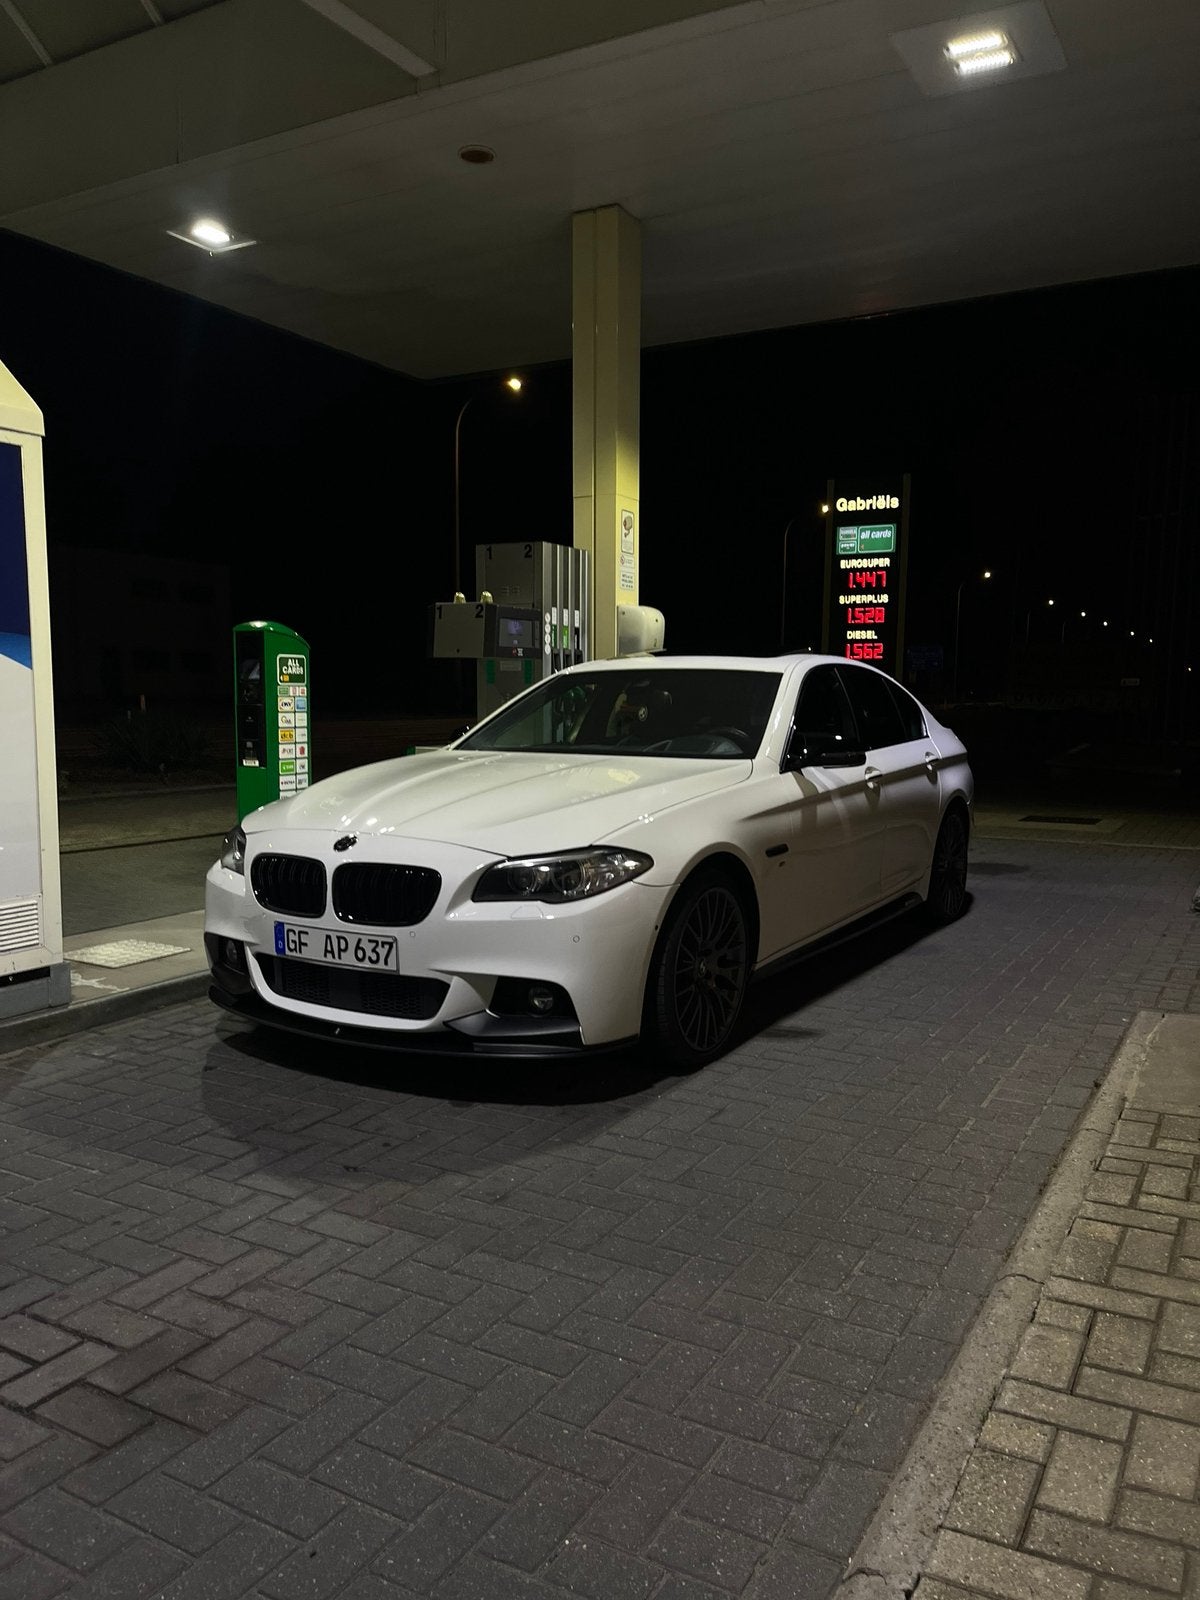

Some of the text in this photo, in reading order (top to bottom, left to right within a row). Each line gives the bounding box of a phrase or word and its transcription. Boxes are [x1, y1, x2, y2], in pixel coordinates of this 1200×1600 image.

[861, 531, 870, 539] all
[871, 530, 891, 539] cards
[486, 546, 493, 560] 1
[524, 544, 533, 559] 2
[840, 558, 890, 569] EUROSUPER
[849, 571, 886, 588] 1.447
[839, 594, 889, 604] SUPERPLUS
[436, 605, 442, 619] 1
[475, 604, 484, 618] 2
[847, 630, 878, 640] DIESEL
[846, 643, 883, 660] 1.562
[288, 659, 299, 667] ALL
[282, 666, 304, 675] CARDS
[286, 929, 394, 966] GF AP 637
